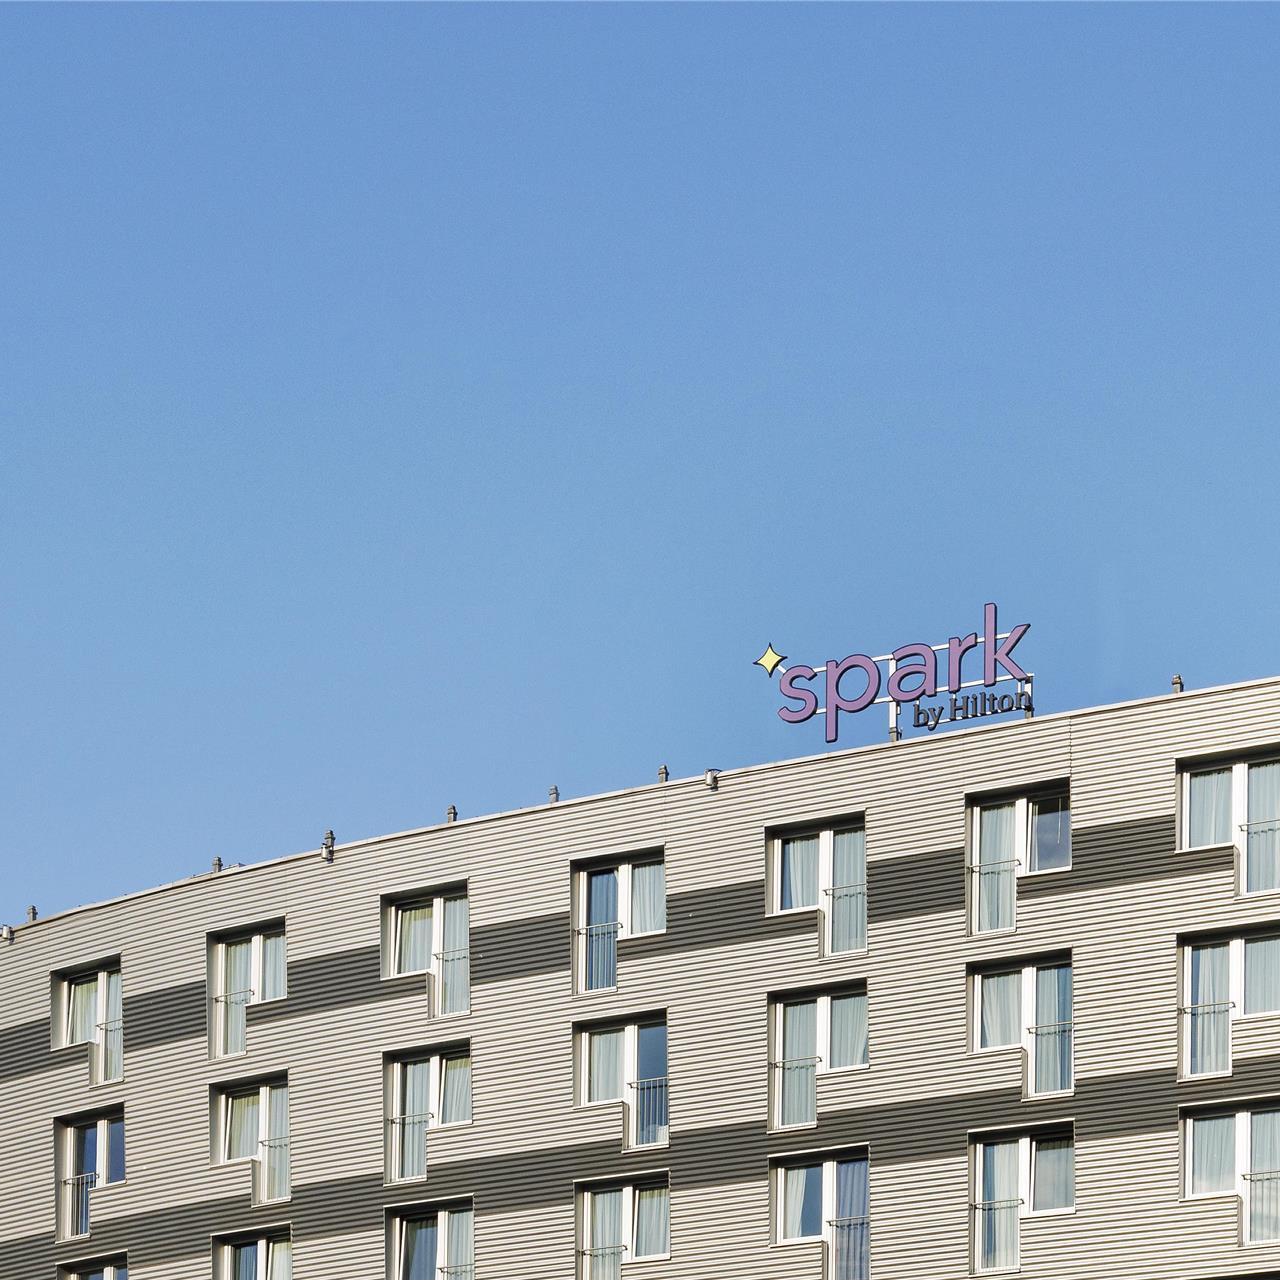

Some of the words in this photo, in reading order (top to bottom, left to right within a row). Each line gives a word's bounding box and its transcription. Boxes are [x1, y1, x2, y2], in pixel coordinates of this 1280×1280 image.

[778, 602, 1031, 742] spark
[913, 703, 944, 731] by
[949, 690, 1033, 722] Hilton
